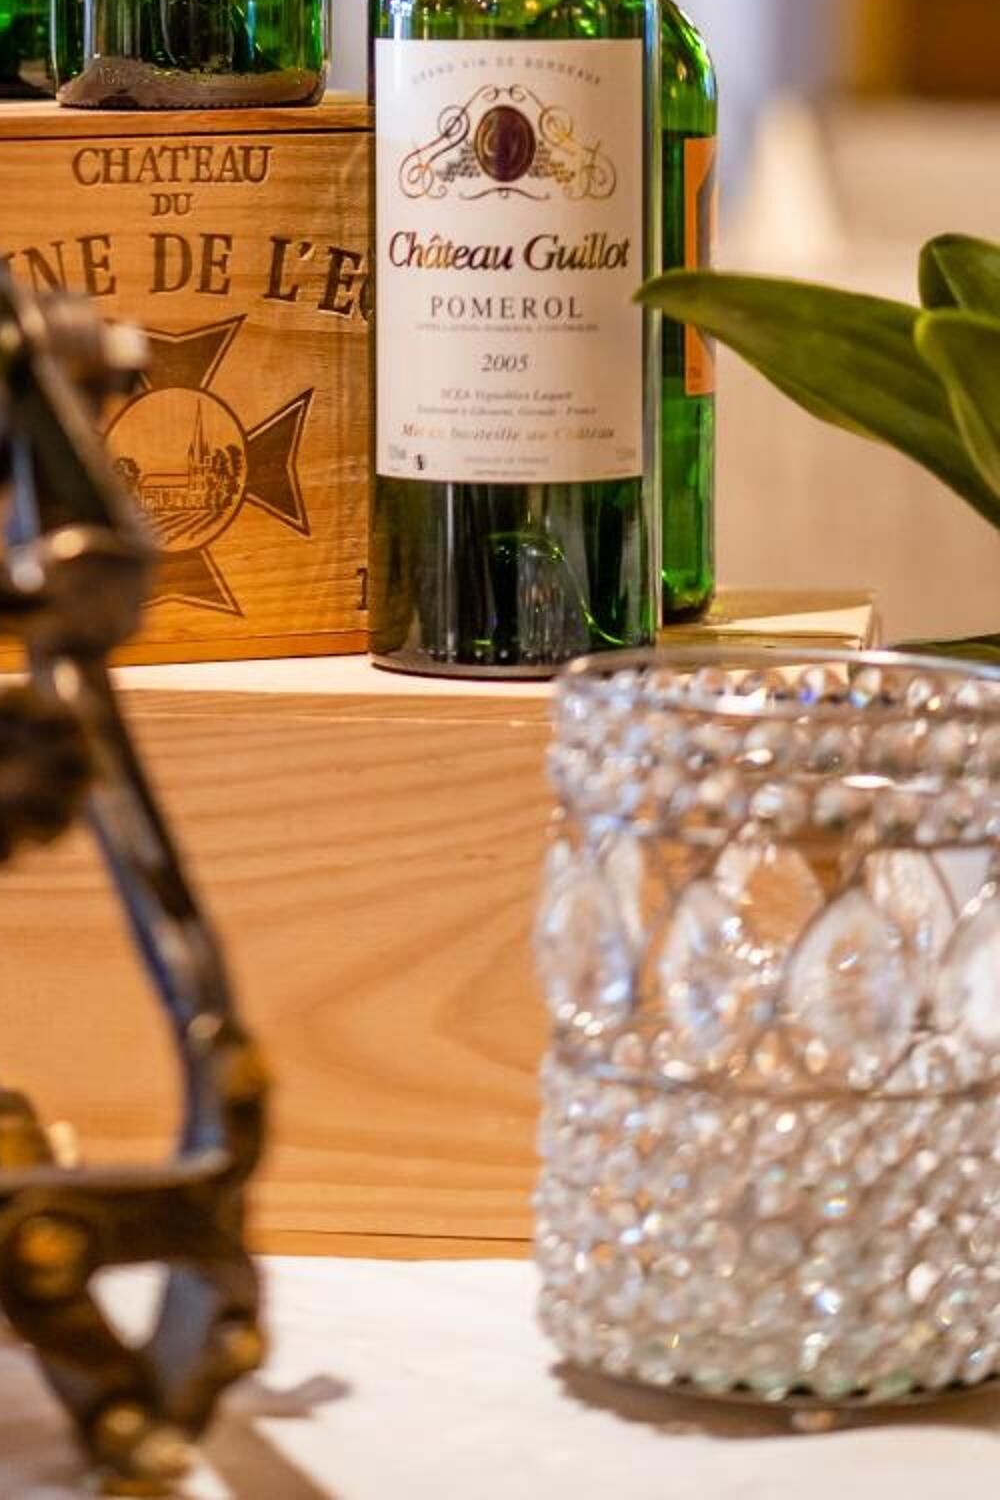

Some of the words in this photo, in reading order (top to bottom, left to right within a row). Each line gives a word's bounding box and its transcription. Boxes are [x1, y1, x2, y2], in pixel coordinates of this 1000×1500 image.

[72, 145, 273, 186] CHATEAU
[151, 193, 194, 216] DU
[388, 231, 514, 271] Château
[523, 232, 631, 271] Guillot
[149, 233, 233, 296] DE
[262, 235, 369, 321] L'E
[430, 296, 583, 319] POMEROL
[480, 353, 529, 372] 2005
